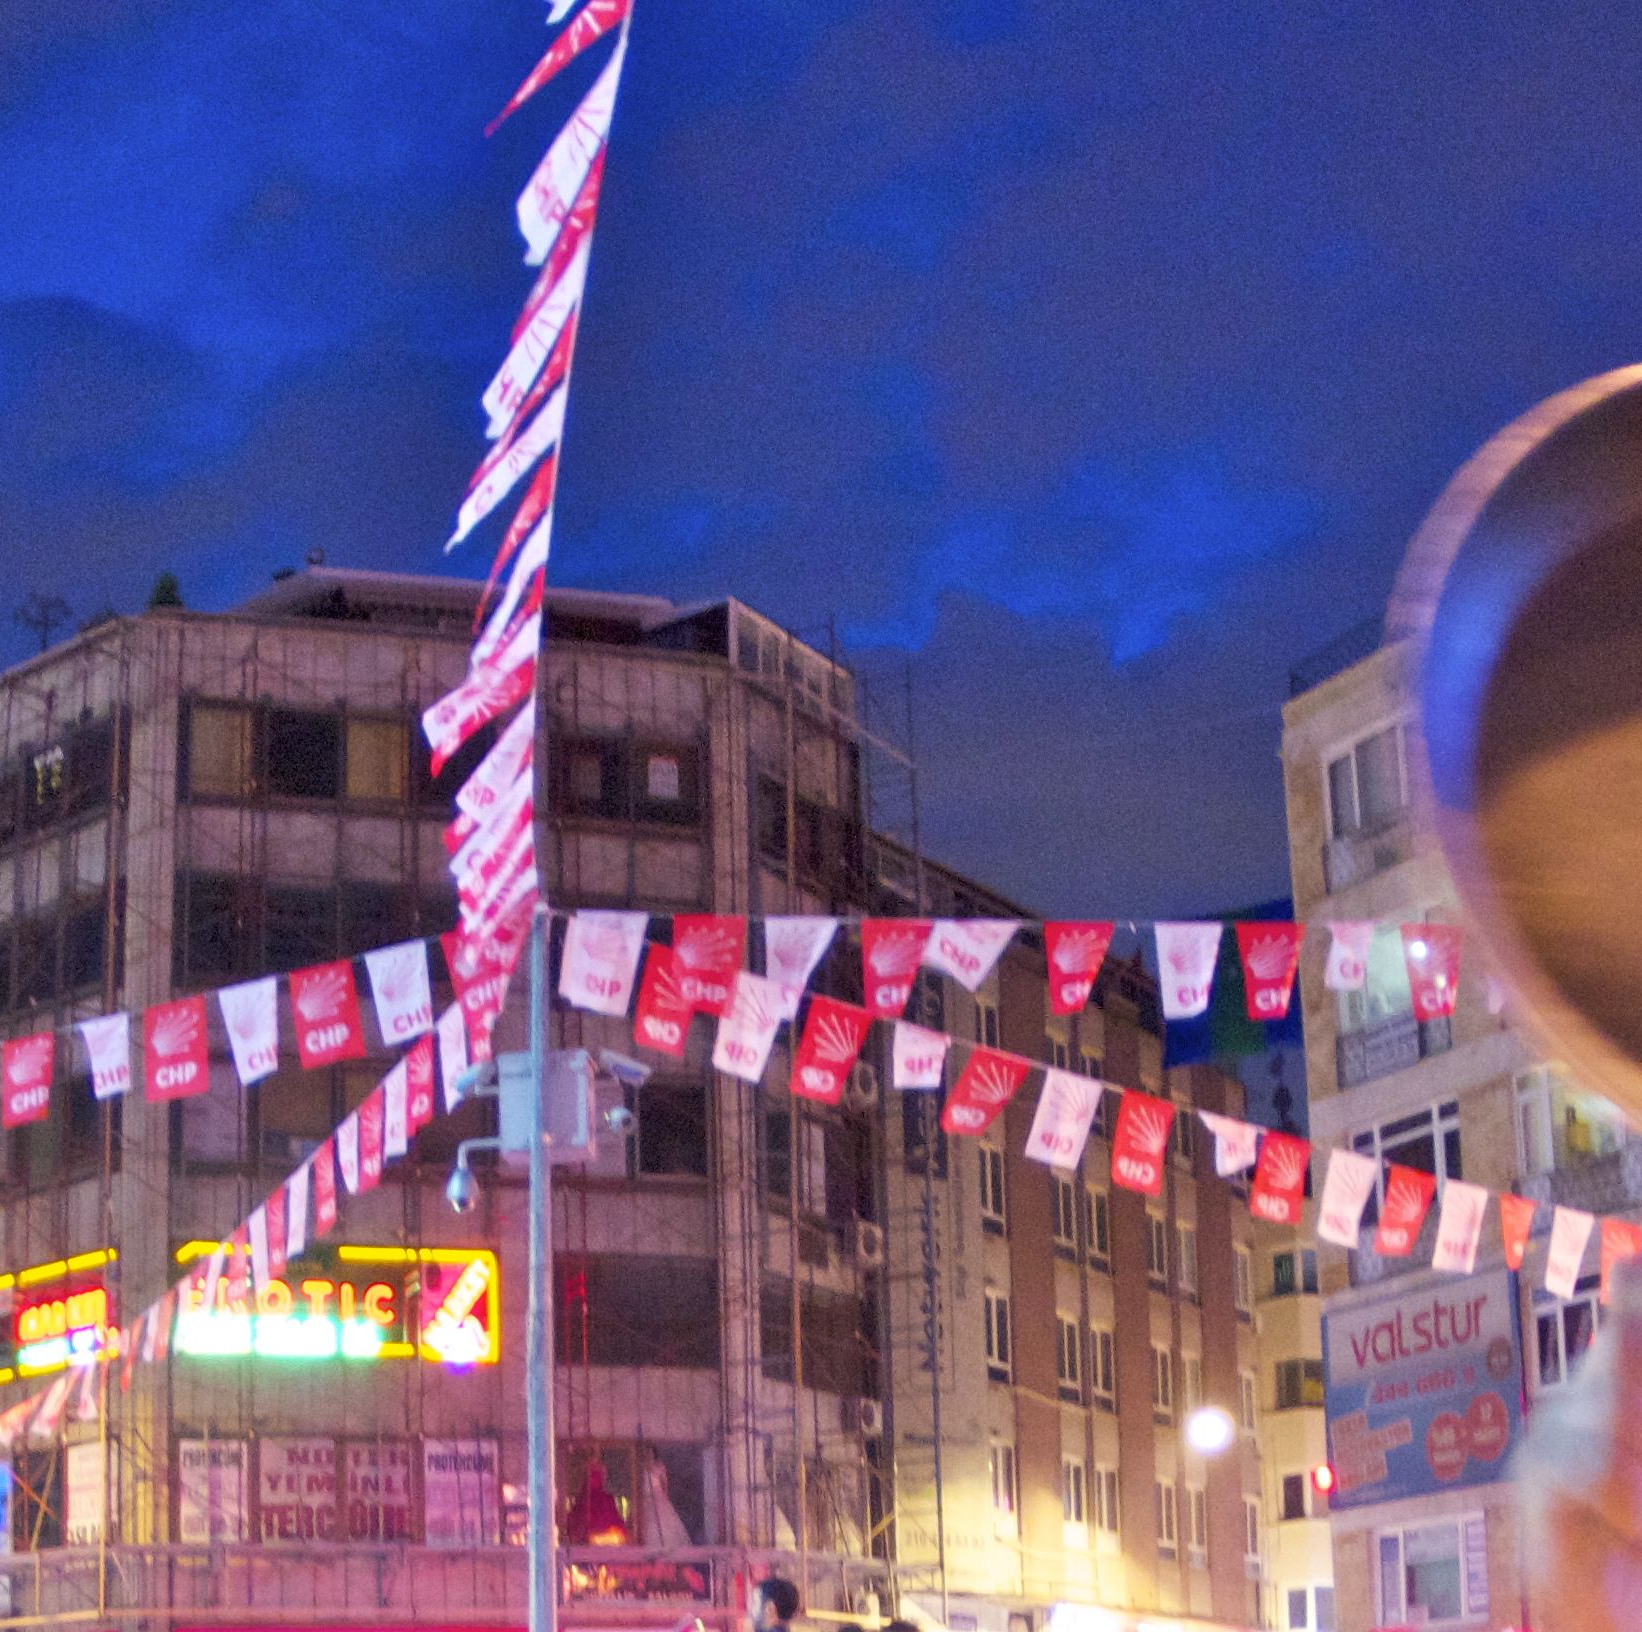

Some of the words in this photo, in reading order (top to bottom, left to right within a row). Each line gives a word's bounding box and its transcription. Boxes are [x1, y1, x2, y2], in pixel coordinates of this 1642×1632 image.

[305, 1022, 350, 1054] CHP
[155, 1061, 198, 1089] CHP
[9, 1086, 51, 1115] CHP
[1350, 1295, 1488, 1368] valstur
